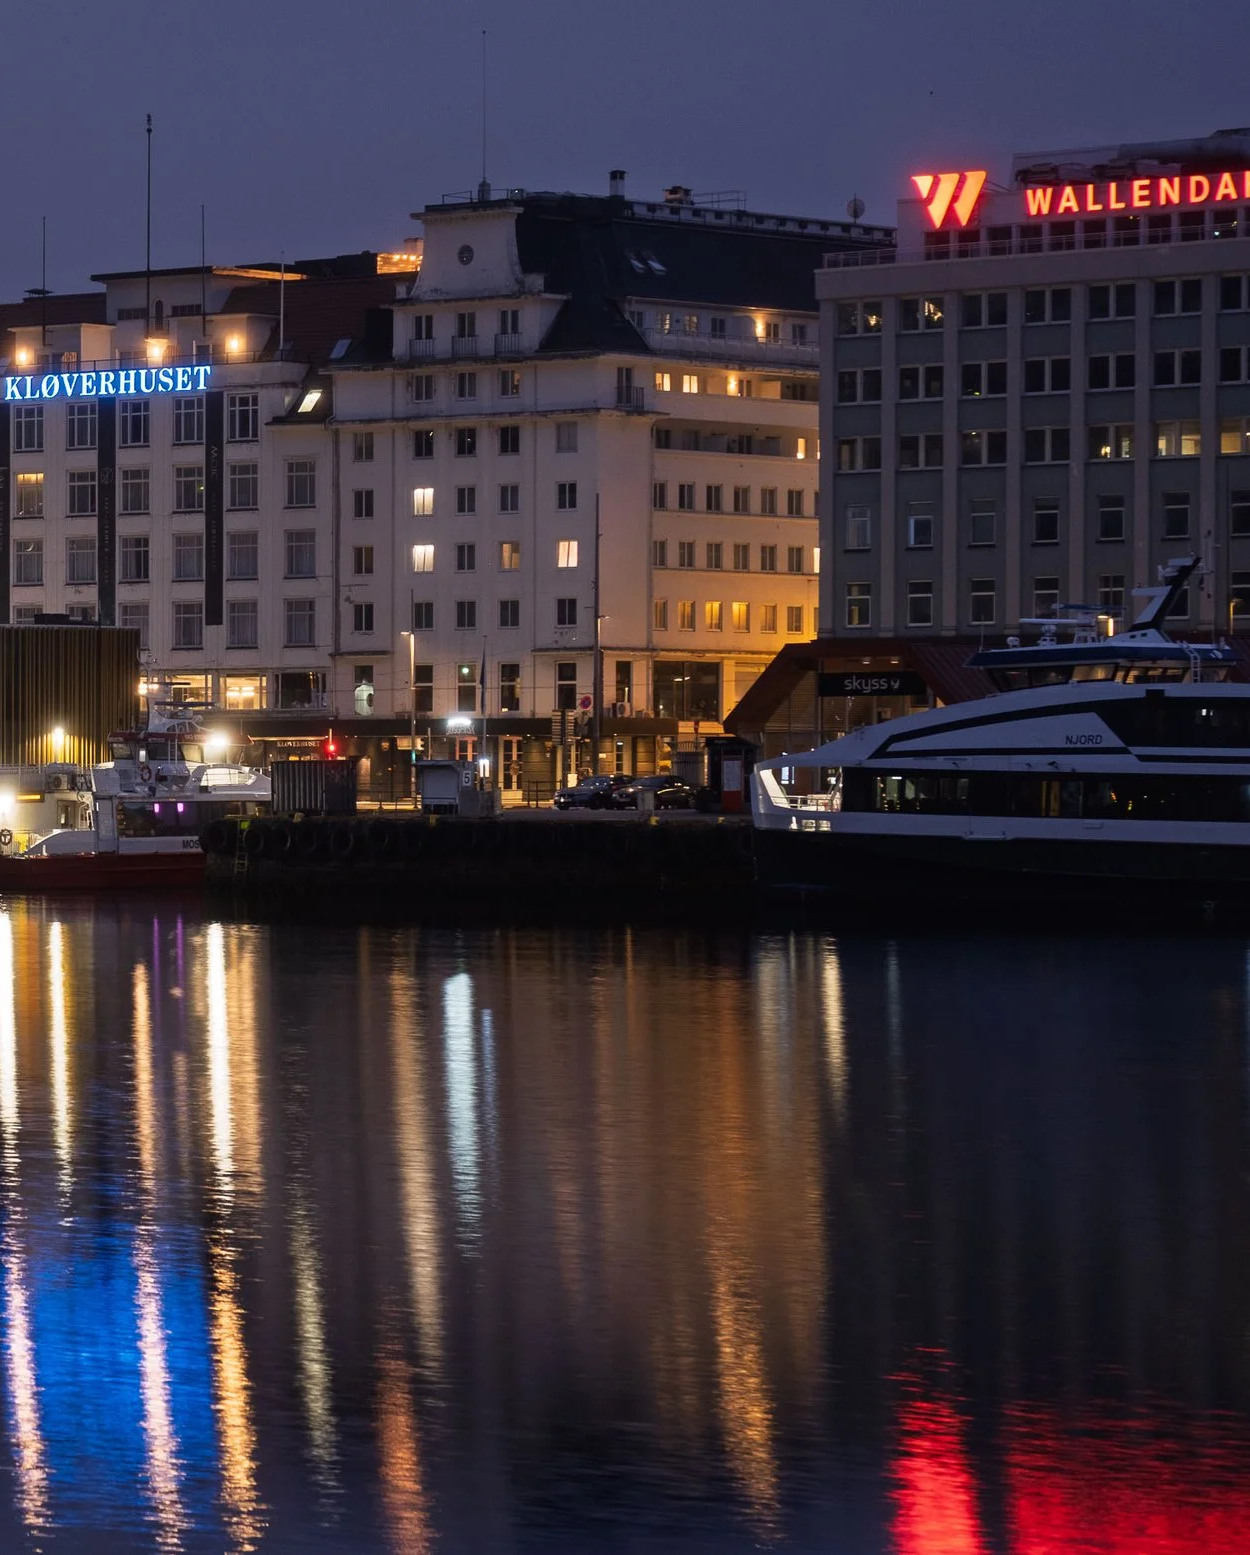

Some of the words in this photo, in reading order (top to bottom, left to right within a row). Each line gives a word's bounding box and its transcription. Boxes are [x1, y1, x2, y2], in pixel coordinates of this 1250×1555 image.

[1026, 170, 1250, 216] WALLENDA
[4, 365, 211, 400] KLØVERHUSET
[843, 674, 889, 693] skyss
[1065, 734, 1103, 745] NJORD
[463, 772, 470, 784] 5
